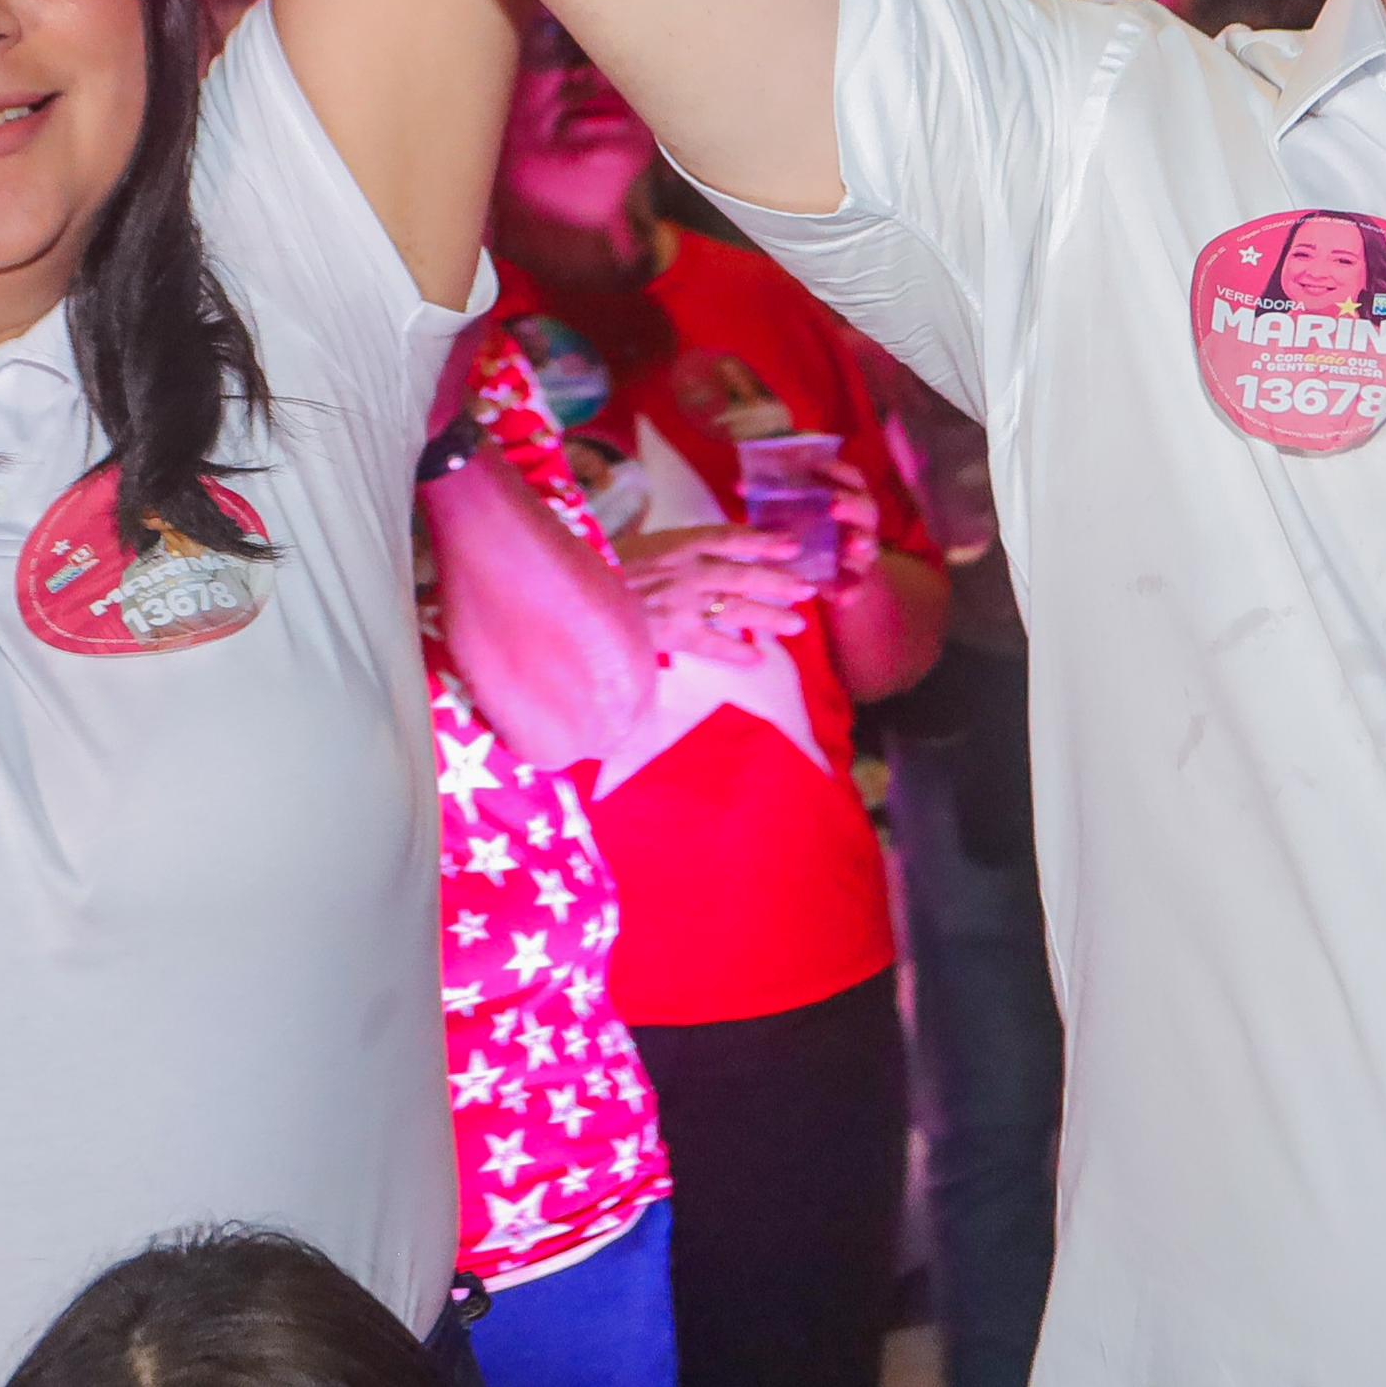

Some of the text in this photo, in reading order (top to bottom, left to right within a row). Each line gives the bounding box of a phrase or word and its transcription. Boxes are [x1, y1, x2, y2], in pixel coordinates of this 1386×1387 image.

[1216, 284, 1305, 313] VEREADORA
[1252, 360, 1384, 380] A GENTE PRECISA
[1261, 352, 1270, 362] O
[1348, 357, 1378, 369] QUE
[121, 581, 238, 634] 13678
